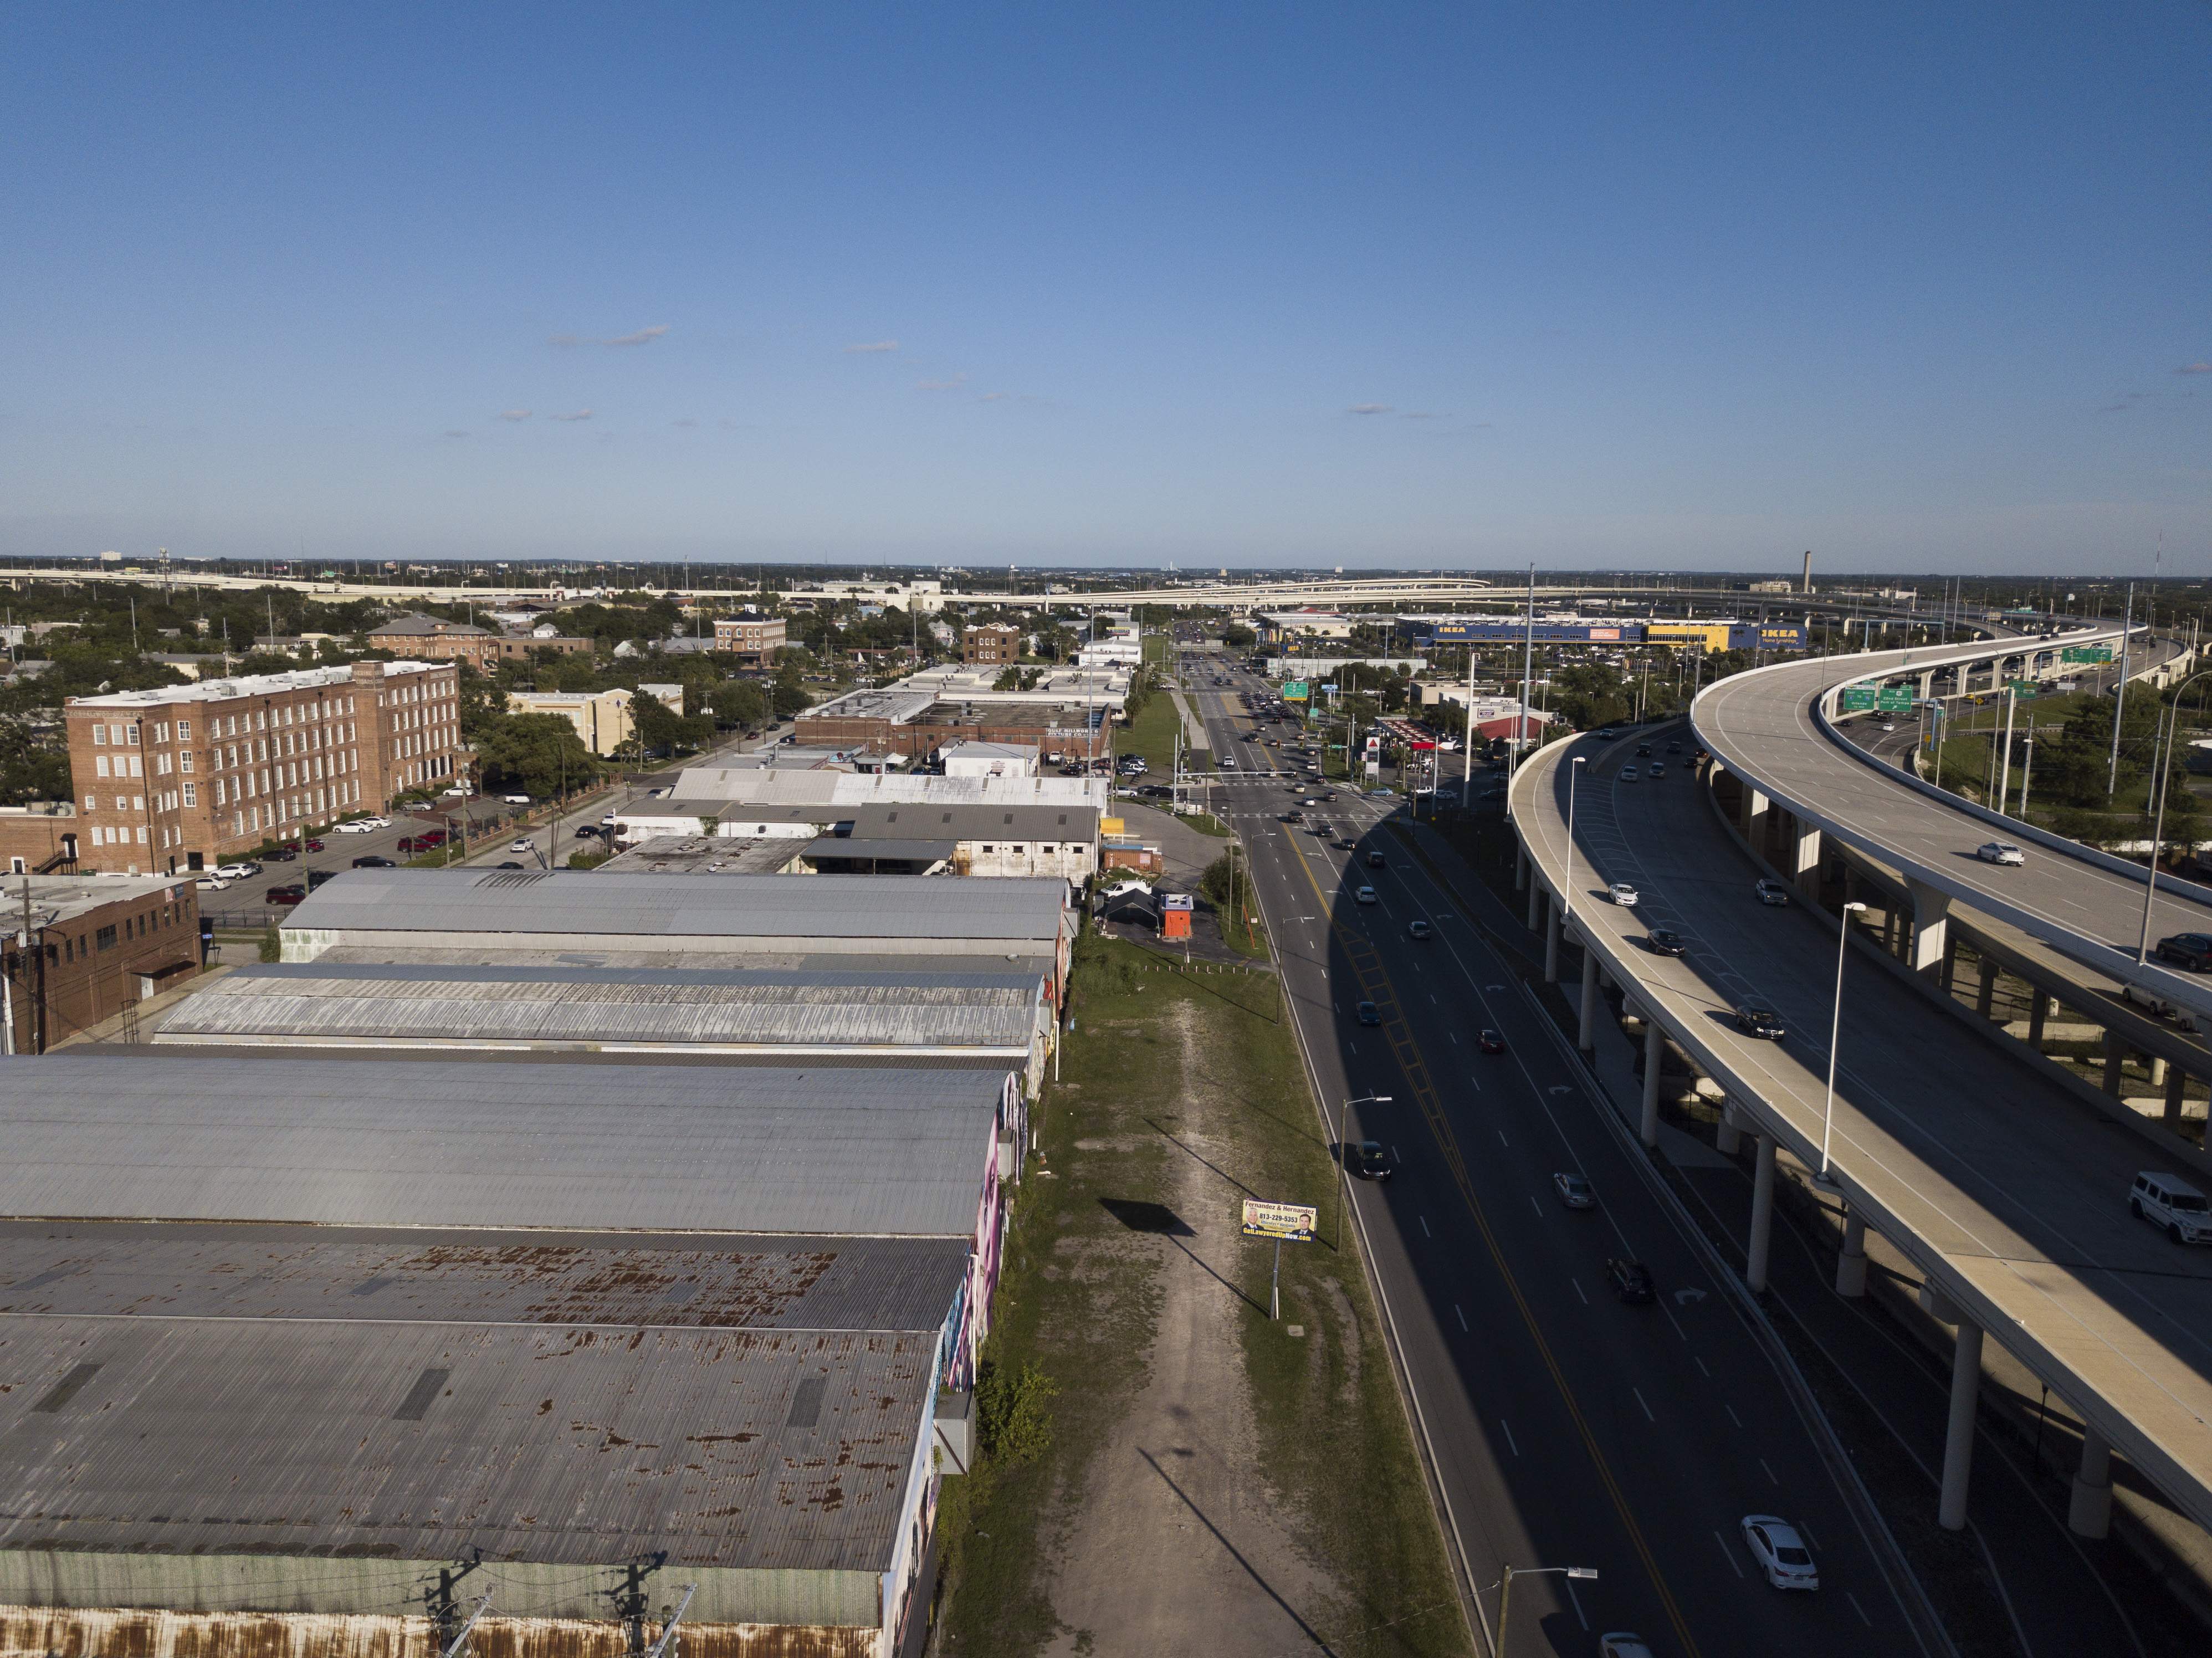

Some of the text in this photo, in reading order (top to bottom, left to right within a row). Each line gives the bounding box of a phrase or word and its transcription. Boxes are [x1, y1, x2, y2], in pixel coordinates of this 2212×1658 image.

[1246, 1201, 1276, 1210] Fernandez
[1283, 1206, 1314, 1215] Hernandez
[1259, 1213, 1298, 1223] 813-229-5353
[1243, 1227, 1311, 1241] GetLawyeredUpNow.com
